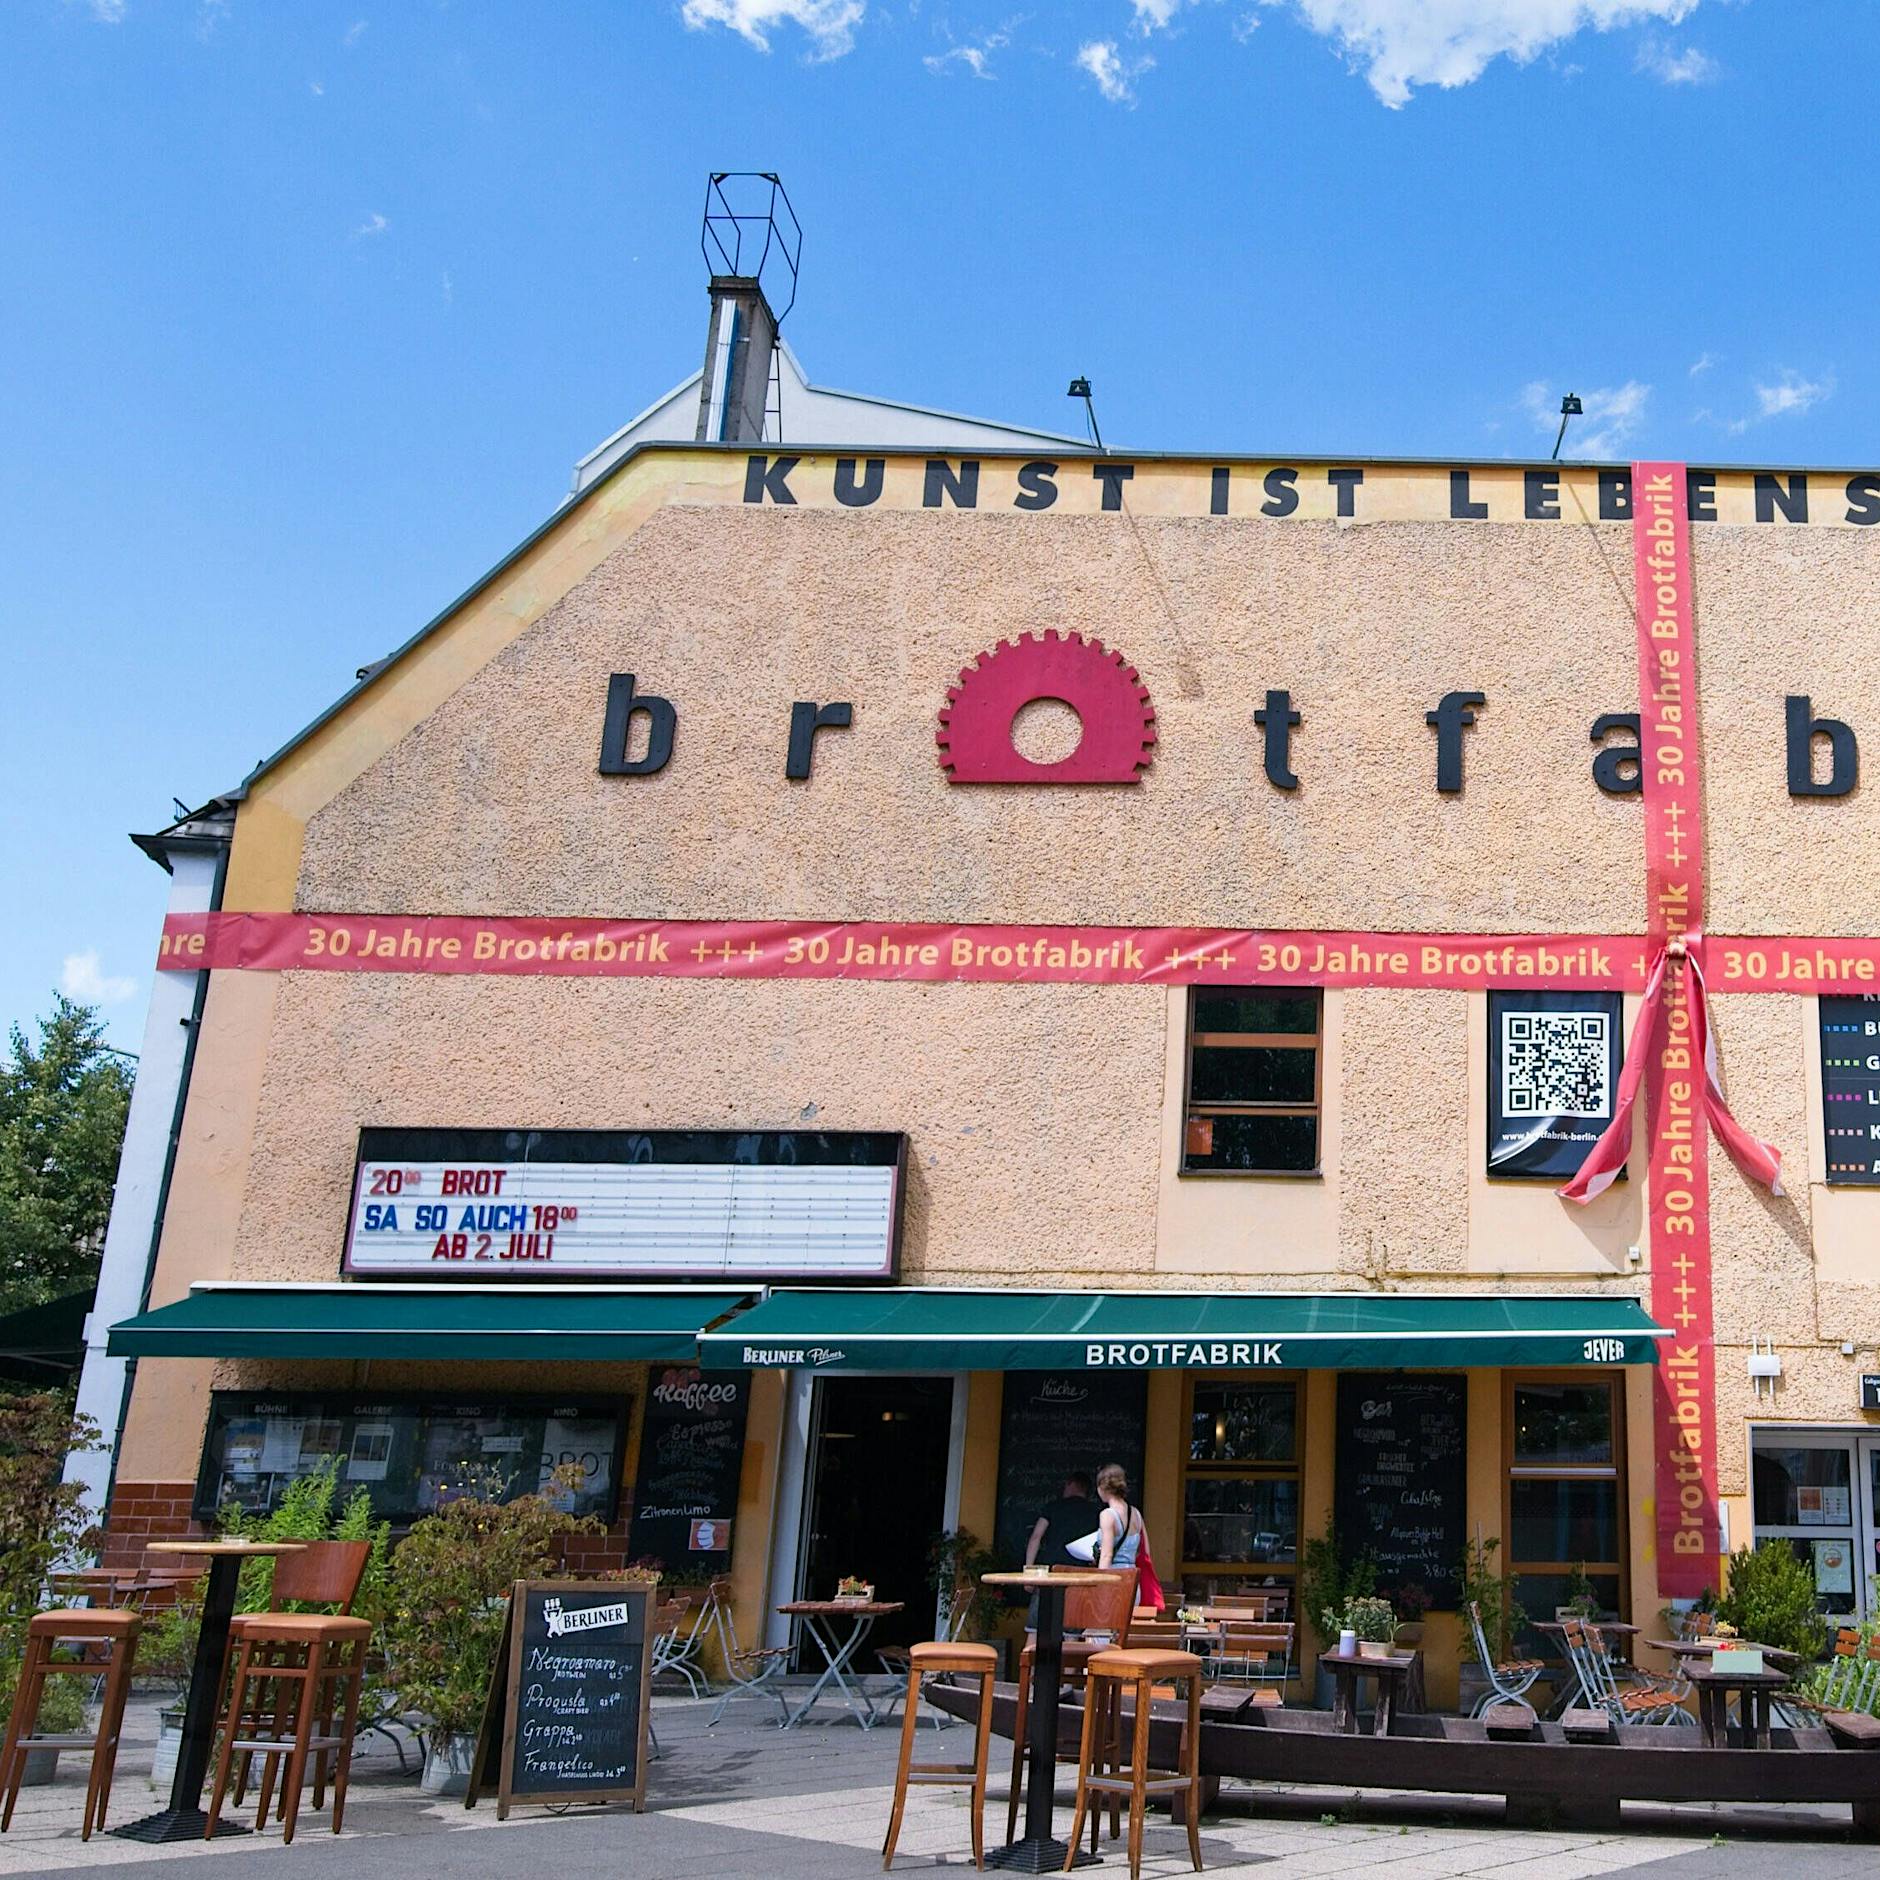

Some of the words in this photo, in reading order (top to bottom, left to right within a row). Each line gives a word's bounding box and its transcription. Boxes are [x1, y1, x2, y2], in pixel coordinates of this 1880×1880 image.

[743, 456, 1134, 511] KUNST
[1210, 467, 1363, 517] IST
[1645, 472, 1680, 640] Brotfabrik
[1652, 649, 1682, 743] Jahre
[1657, 745, 1685, 787] 30
[304, 928, 351, 957] 30
[358, 927, 461, 960] Jahre
[473, 930, 670, 963] Brotfabrik
[784, 936, 830, 965] 30
[836, 935, 938, 967] Jahre
[951, 937, 1145, 970] Brotfabrik
[1257, 943, 1301, 973] 30
[1309, 943, 1409, 974] Jahre
[1420, 946, 1612, 977] Brotfabrik
[1723, 952, 1767, 980] 30
[1776, 949, 1875, 981] Jahre
[1664, 1080, 1694, 1184] Jahre
[441, 1170, 507, 1196] BROT
[364, 1204, 398, 1231] SA
[415, 1204, 448, 1231] SO
[458, 1204, 528, 1232] AUCH
[1665, 1188, 1694, 1236] 30
[432, 1233, 468, 1260] AB
[499, 1233, 554, 1260] JULI
[743, 1346, 805, 1366] BERLINER
[807, 1347, 846, 1366] Pilsner
[1086, 1343, 1283, 1366] BROTFABRIK
[1583, 1338, 1625, 1361] JEVER
[254, 1403, 288, 1414] BÜHNE
[353, 1405, 393, 1415] GALERIE
[456, 1406, 481, 1416] KINO
[653, 1383, 737, 1411] Kaffee
[1667, 1342, 1704, 1556] Brotfabrik
[563, 1607, 624, 1629] BERLINER
[527, 1646, 616, 1682] Negroamaro
[523, 1719, 575, 1748] Grappa
[525, 1749, 594, 1778] Frangelico
